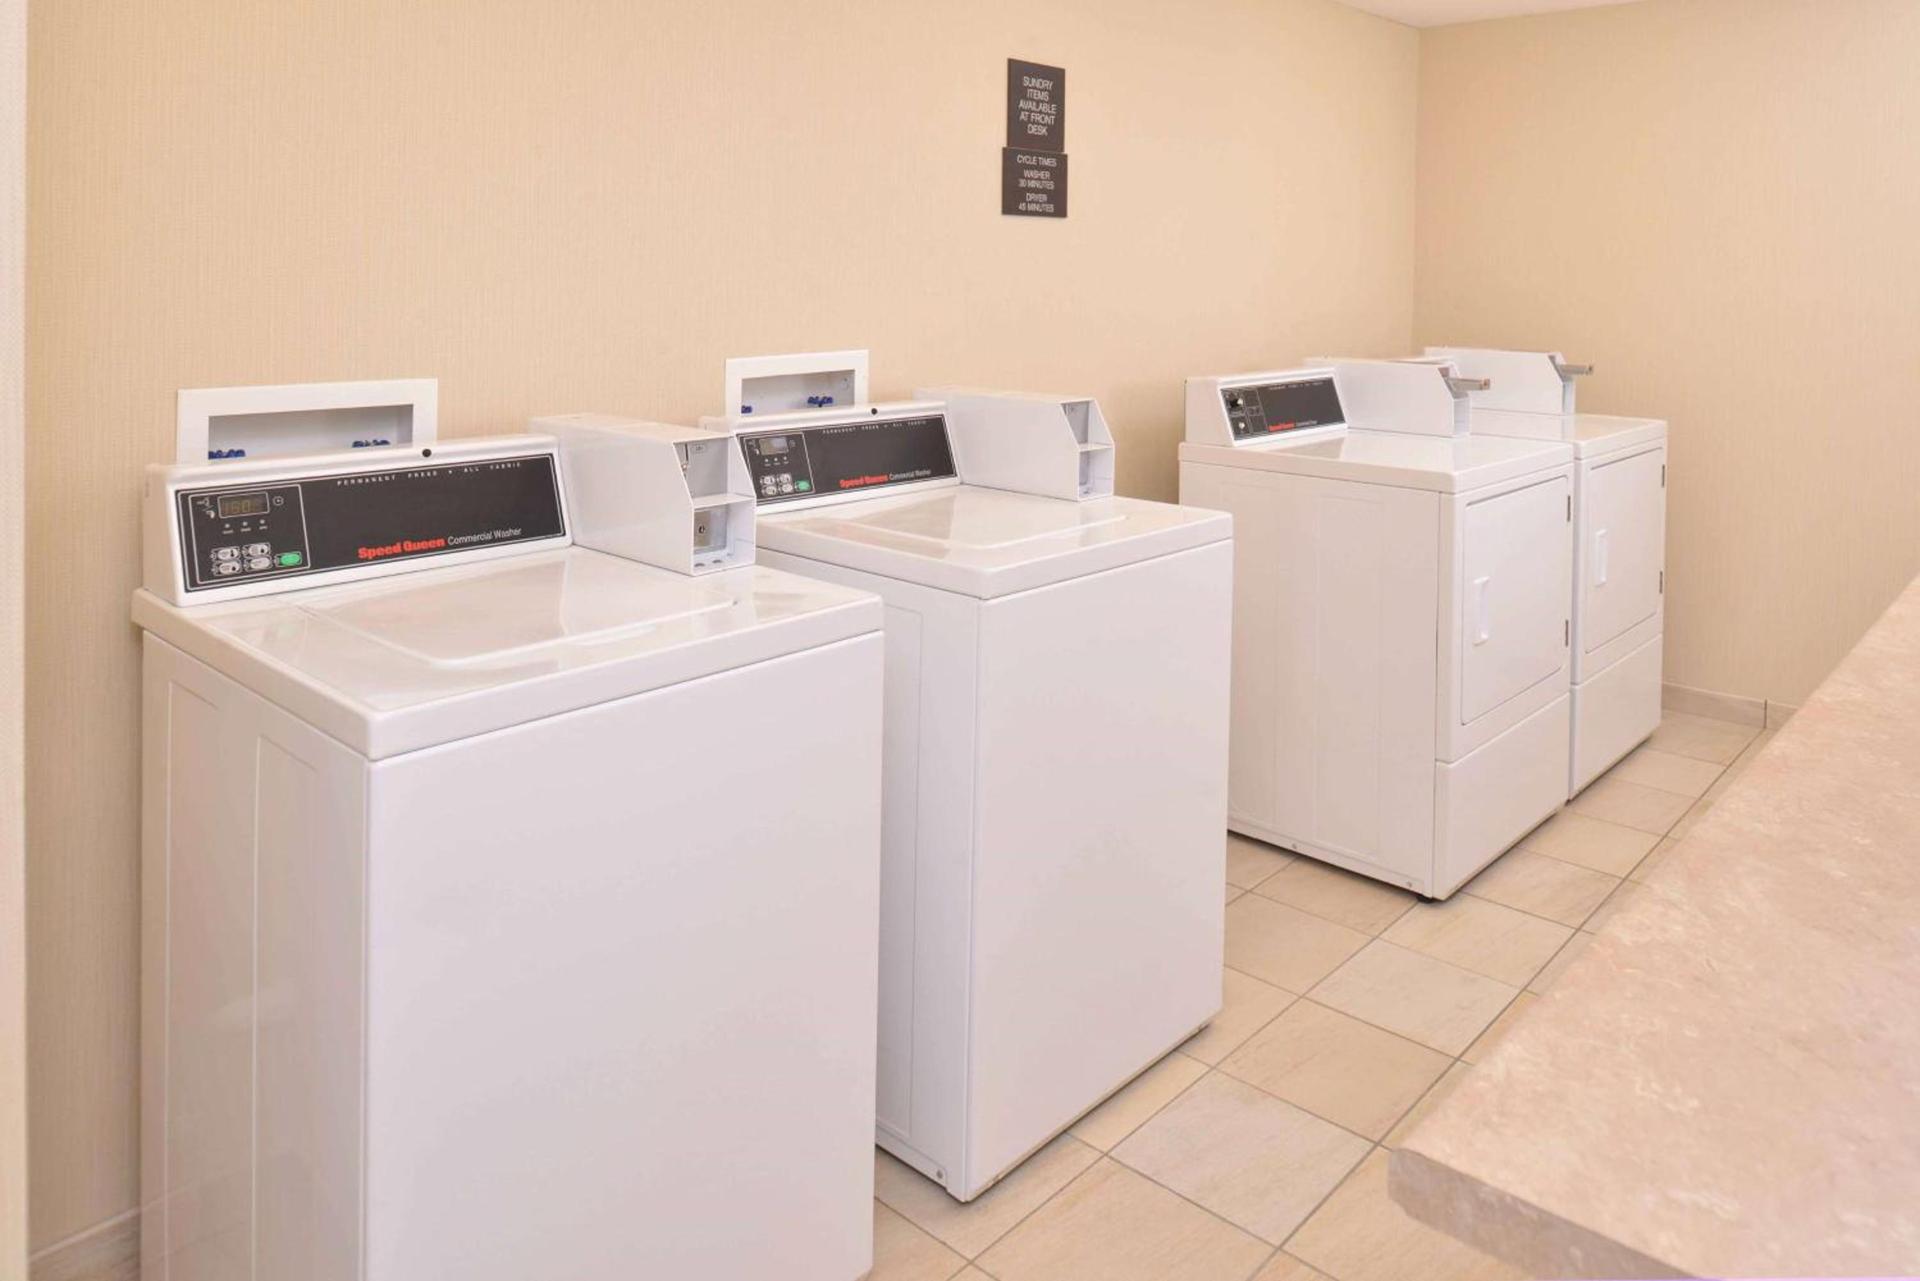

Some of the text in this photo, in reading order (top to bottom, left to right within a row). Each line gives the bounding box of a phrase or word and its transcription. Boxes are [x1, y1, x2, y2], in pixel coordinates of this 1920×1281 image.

[1023, 76, 1054, 91] SUNDRY
[1027, 89, 1049, 101] ITEMS
[1019, 99, 1057, 114] AVAILABLE
[1020, 111, 1056, 125] AT FRONT
[1027, 124, 1048, 136] DESK
[1017, 154, 1057, 168] CYCLE TIMES
[1023, 169, 1050, 180] WASHER
[1018, 178, 1055, 190] 30 MINUTES
[1026, 193, 1047, 203] DRYER
[1018, 202, 1054, 213] 45 MINUTES
[337, 474, 396, 486] PERMANENT
[357, 527, 523, 560] Speed Queen Commercial Washer
